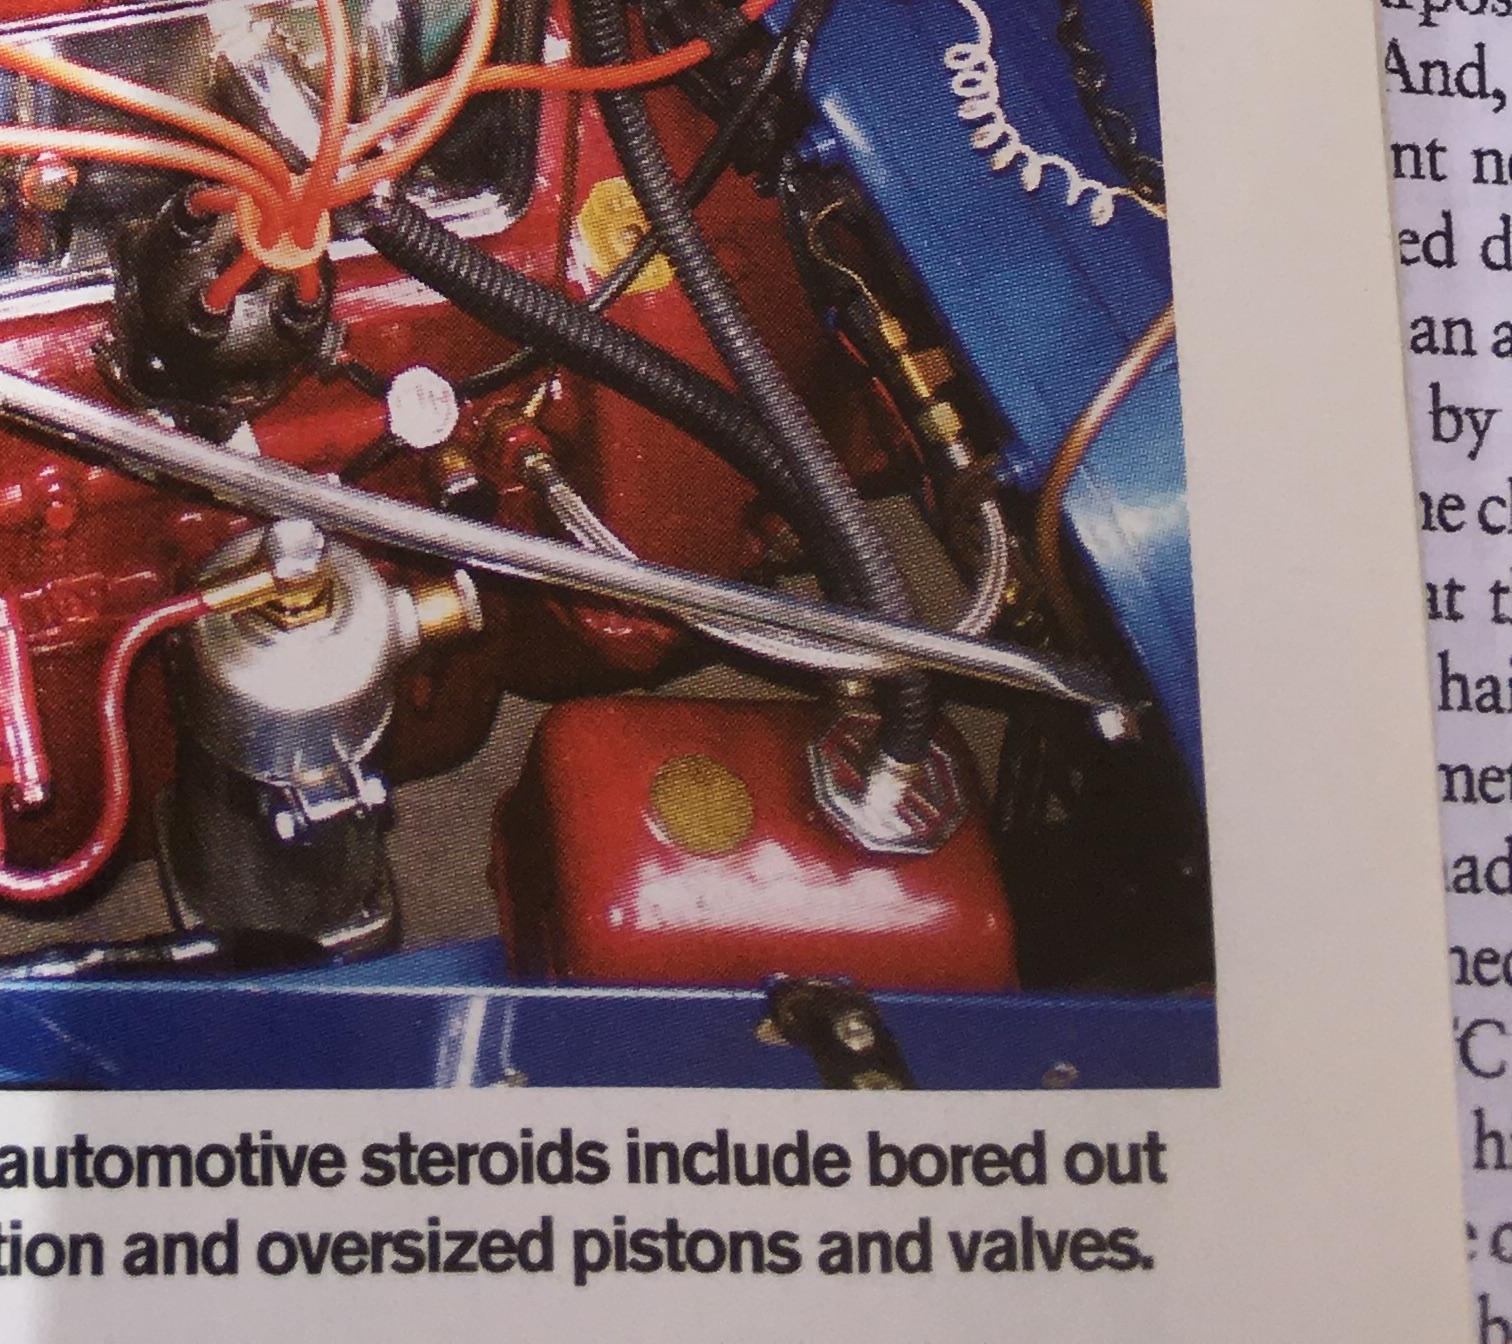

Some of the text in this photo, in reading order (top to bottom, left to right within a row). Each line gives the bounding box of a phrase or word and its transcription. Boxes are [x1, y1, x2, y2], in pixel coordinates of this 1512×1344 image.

[1385, 37, 1506, 113] And,
[1409, 316, 1478, 357] an
[1428, 381, 1502, 461] by
[1446, 835, 1512, 895] ad
[360, 1128, 611, 1187] steroids
[626, 1128, 852, 1188] include
[868, 1130, 1048, 1187] bored
[1063, 1131, 1168, 1186] out
[122, 1217, 239, 1277] and
[256, 1216, 555, 1277] oversized
[572, 1215, 803, 1287] pistons
[817, 1216, 934, 1276] and
[947, 1216, 1155, 1274] valves.
